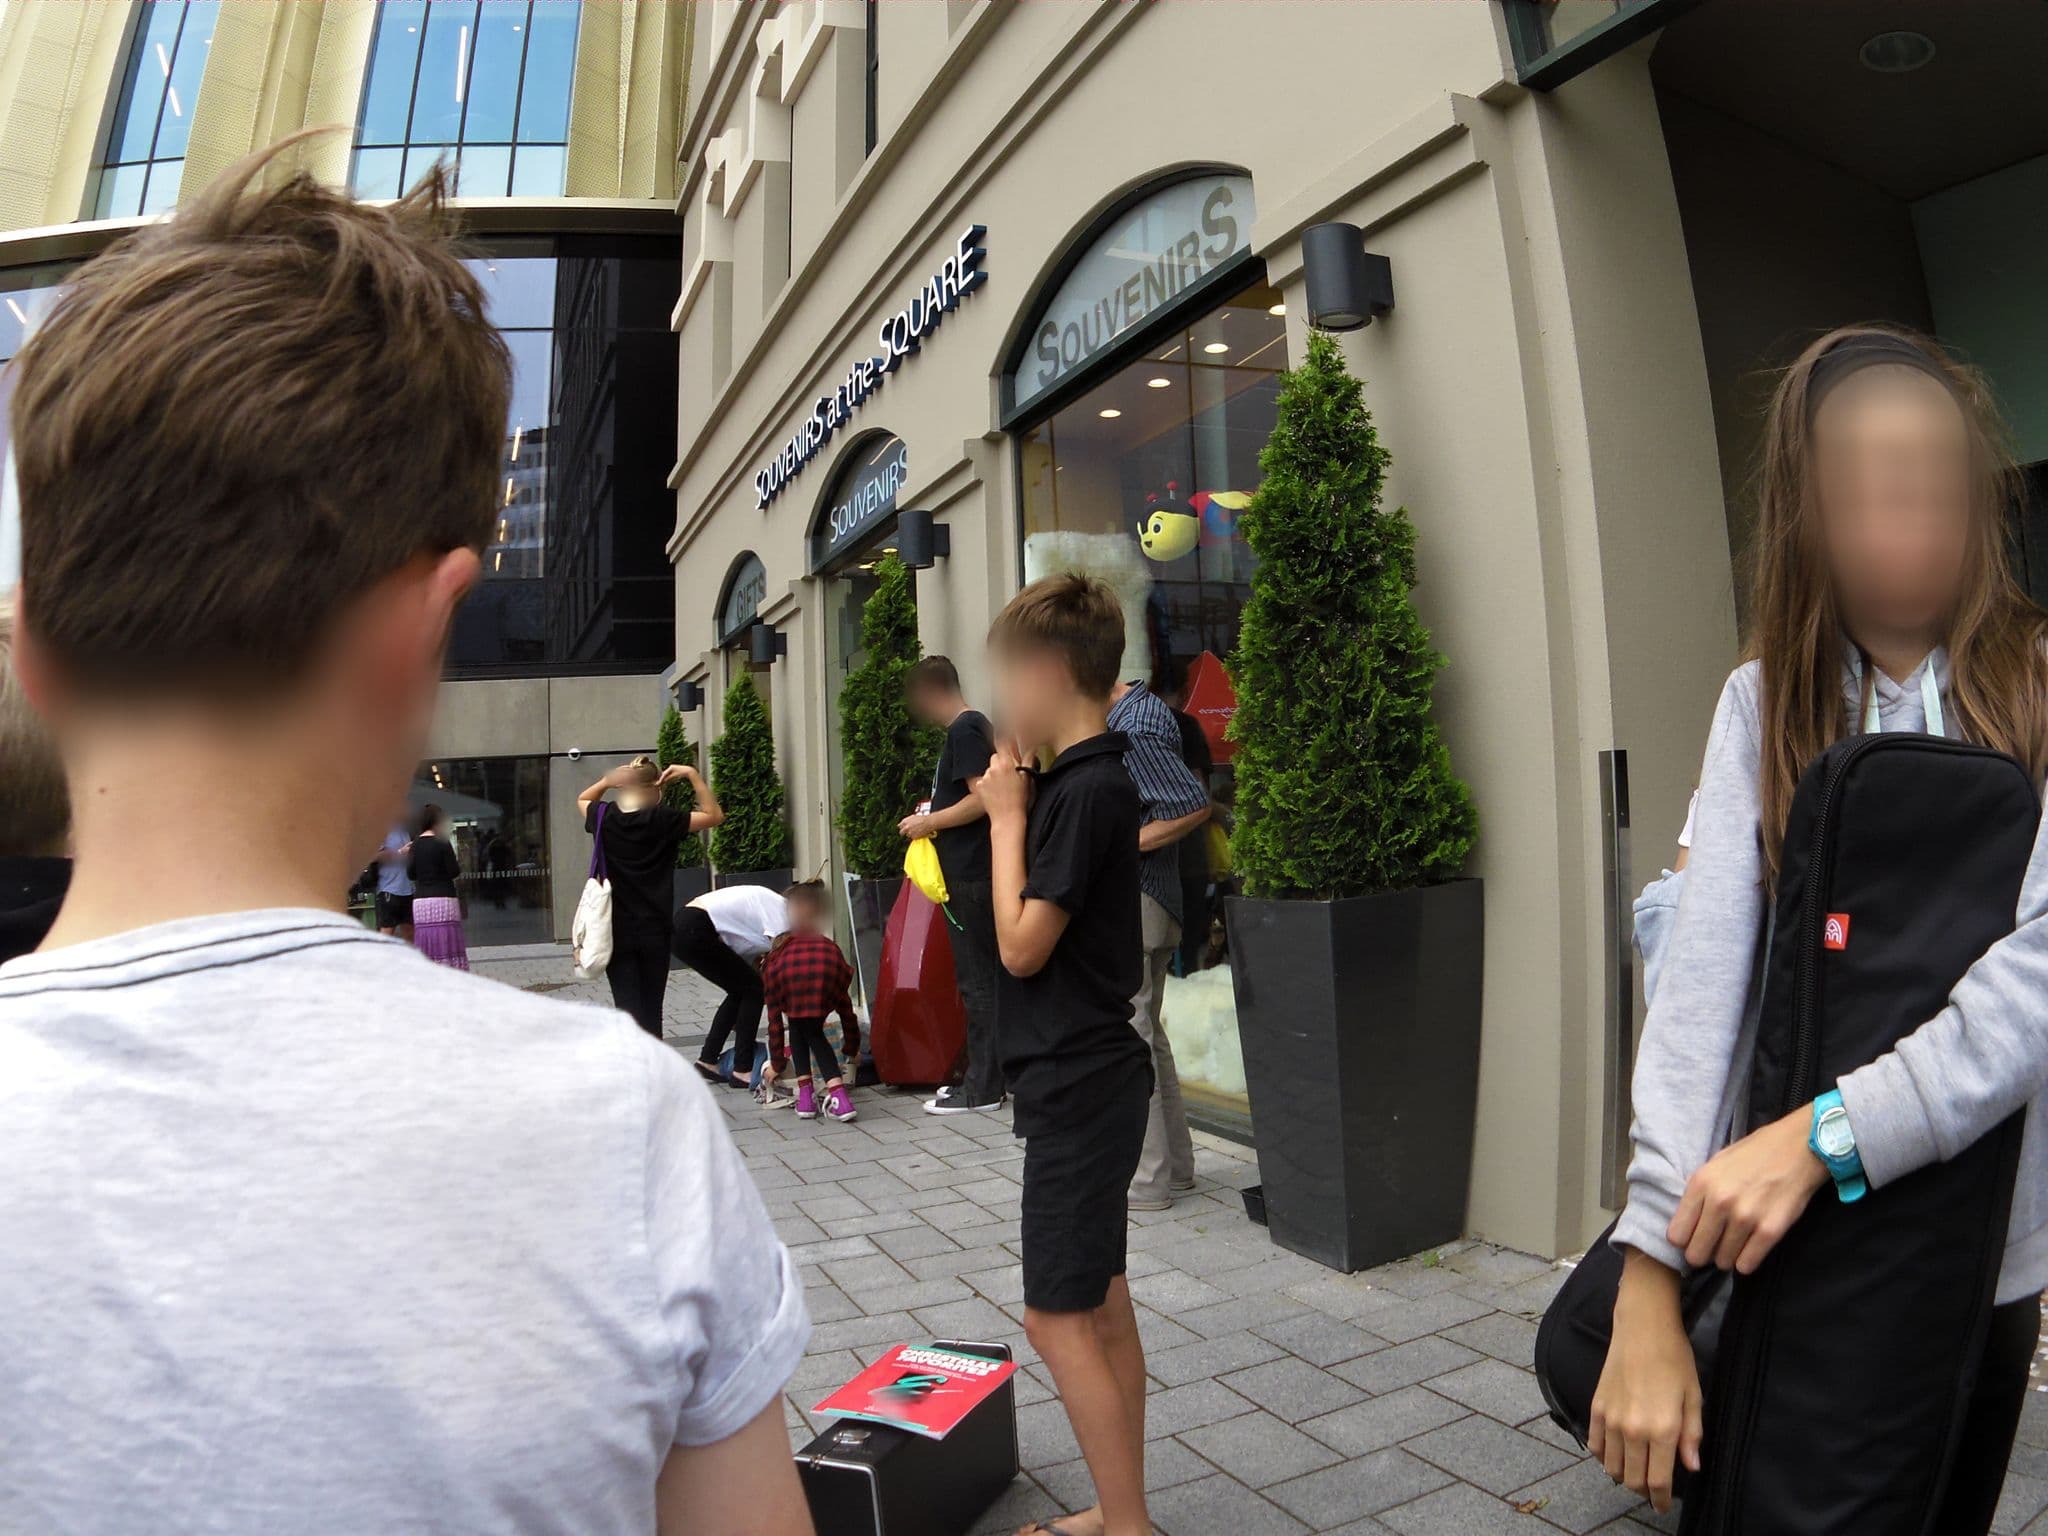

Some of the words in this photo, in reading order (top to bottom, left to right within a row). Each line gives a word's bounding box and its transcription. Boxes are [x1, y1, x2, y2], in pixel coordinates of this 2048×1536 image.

[755, 396, 825, 510] SOUVENIRS
[827, 386, 842, 428] at
[846, 357, 875, 407] the
[879, 224, 977, 373] SQUARE
[1036, 185, 1238, 386] SOUVENIRS
[830, 447, 908, 543] SOUVENIRS
